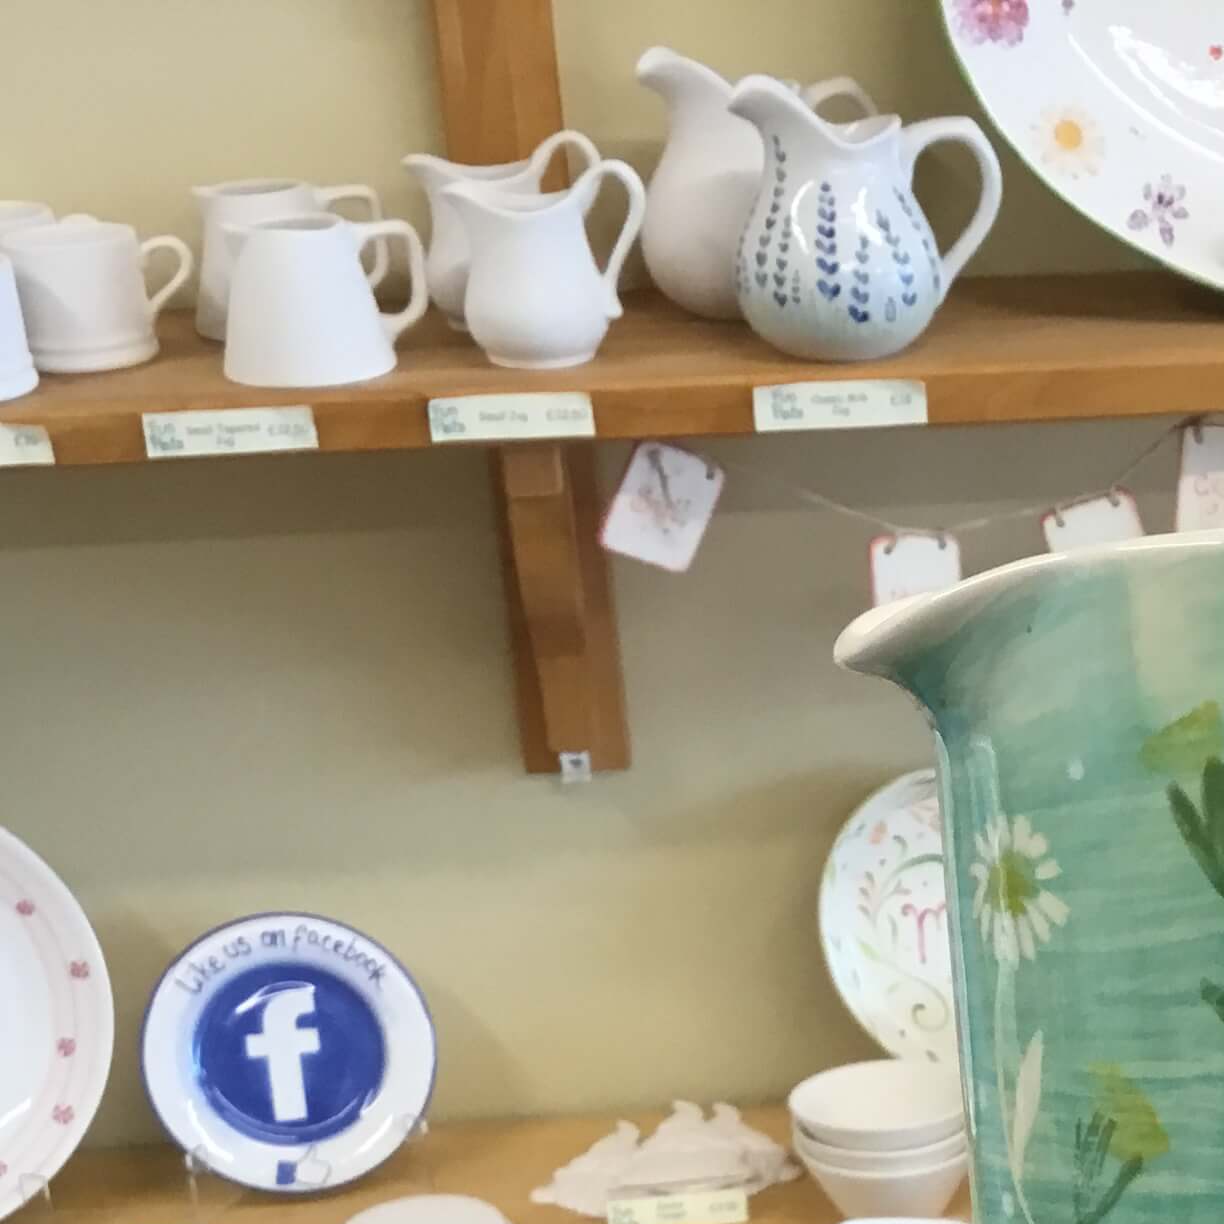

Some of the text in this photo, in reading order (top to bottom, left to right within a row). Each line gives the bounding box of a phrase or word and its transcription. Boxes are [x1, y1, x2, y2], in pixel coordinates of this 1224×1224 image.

[177, 956, 225, 994] Like
[223, 937, 252, 958] us
[292, 925, 387, 991] facebook
[245, 987, 321, 1121] f
